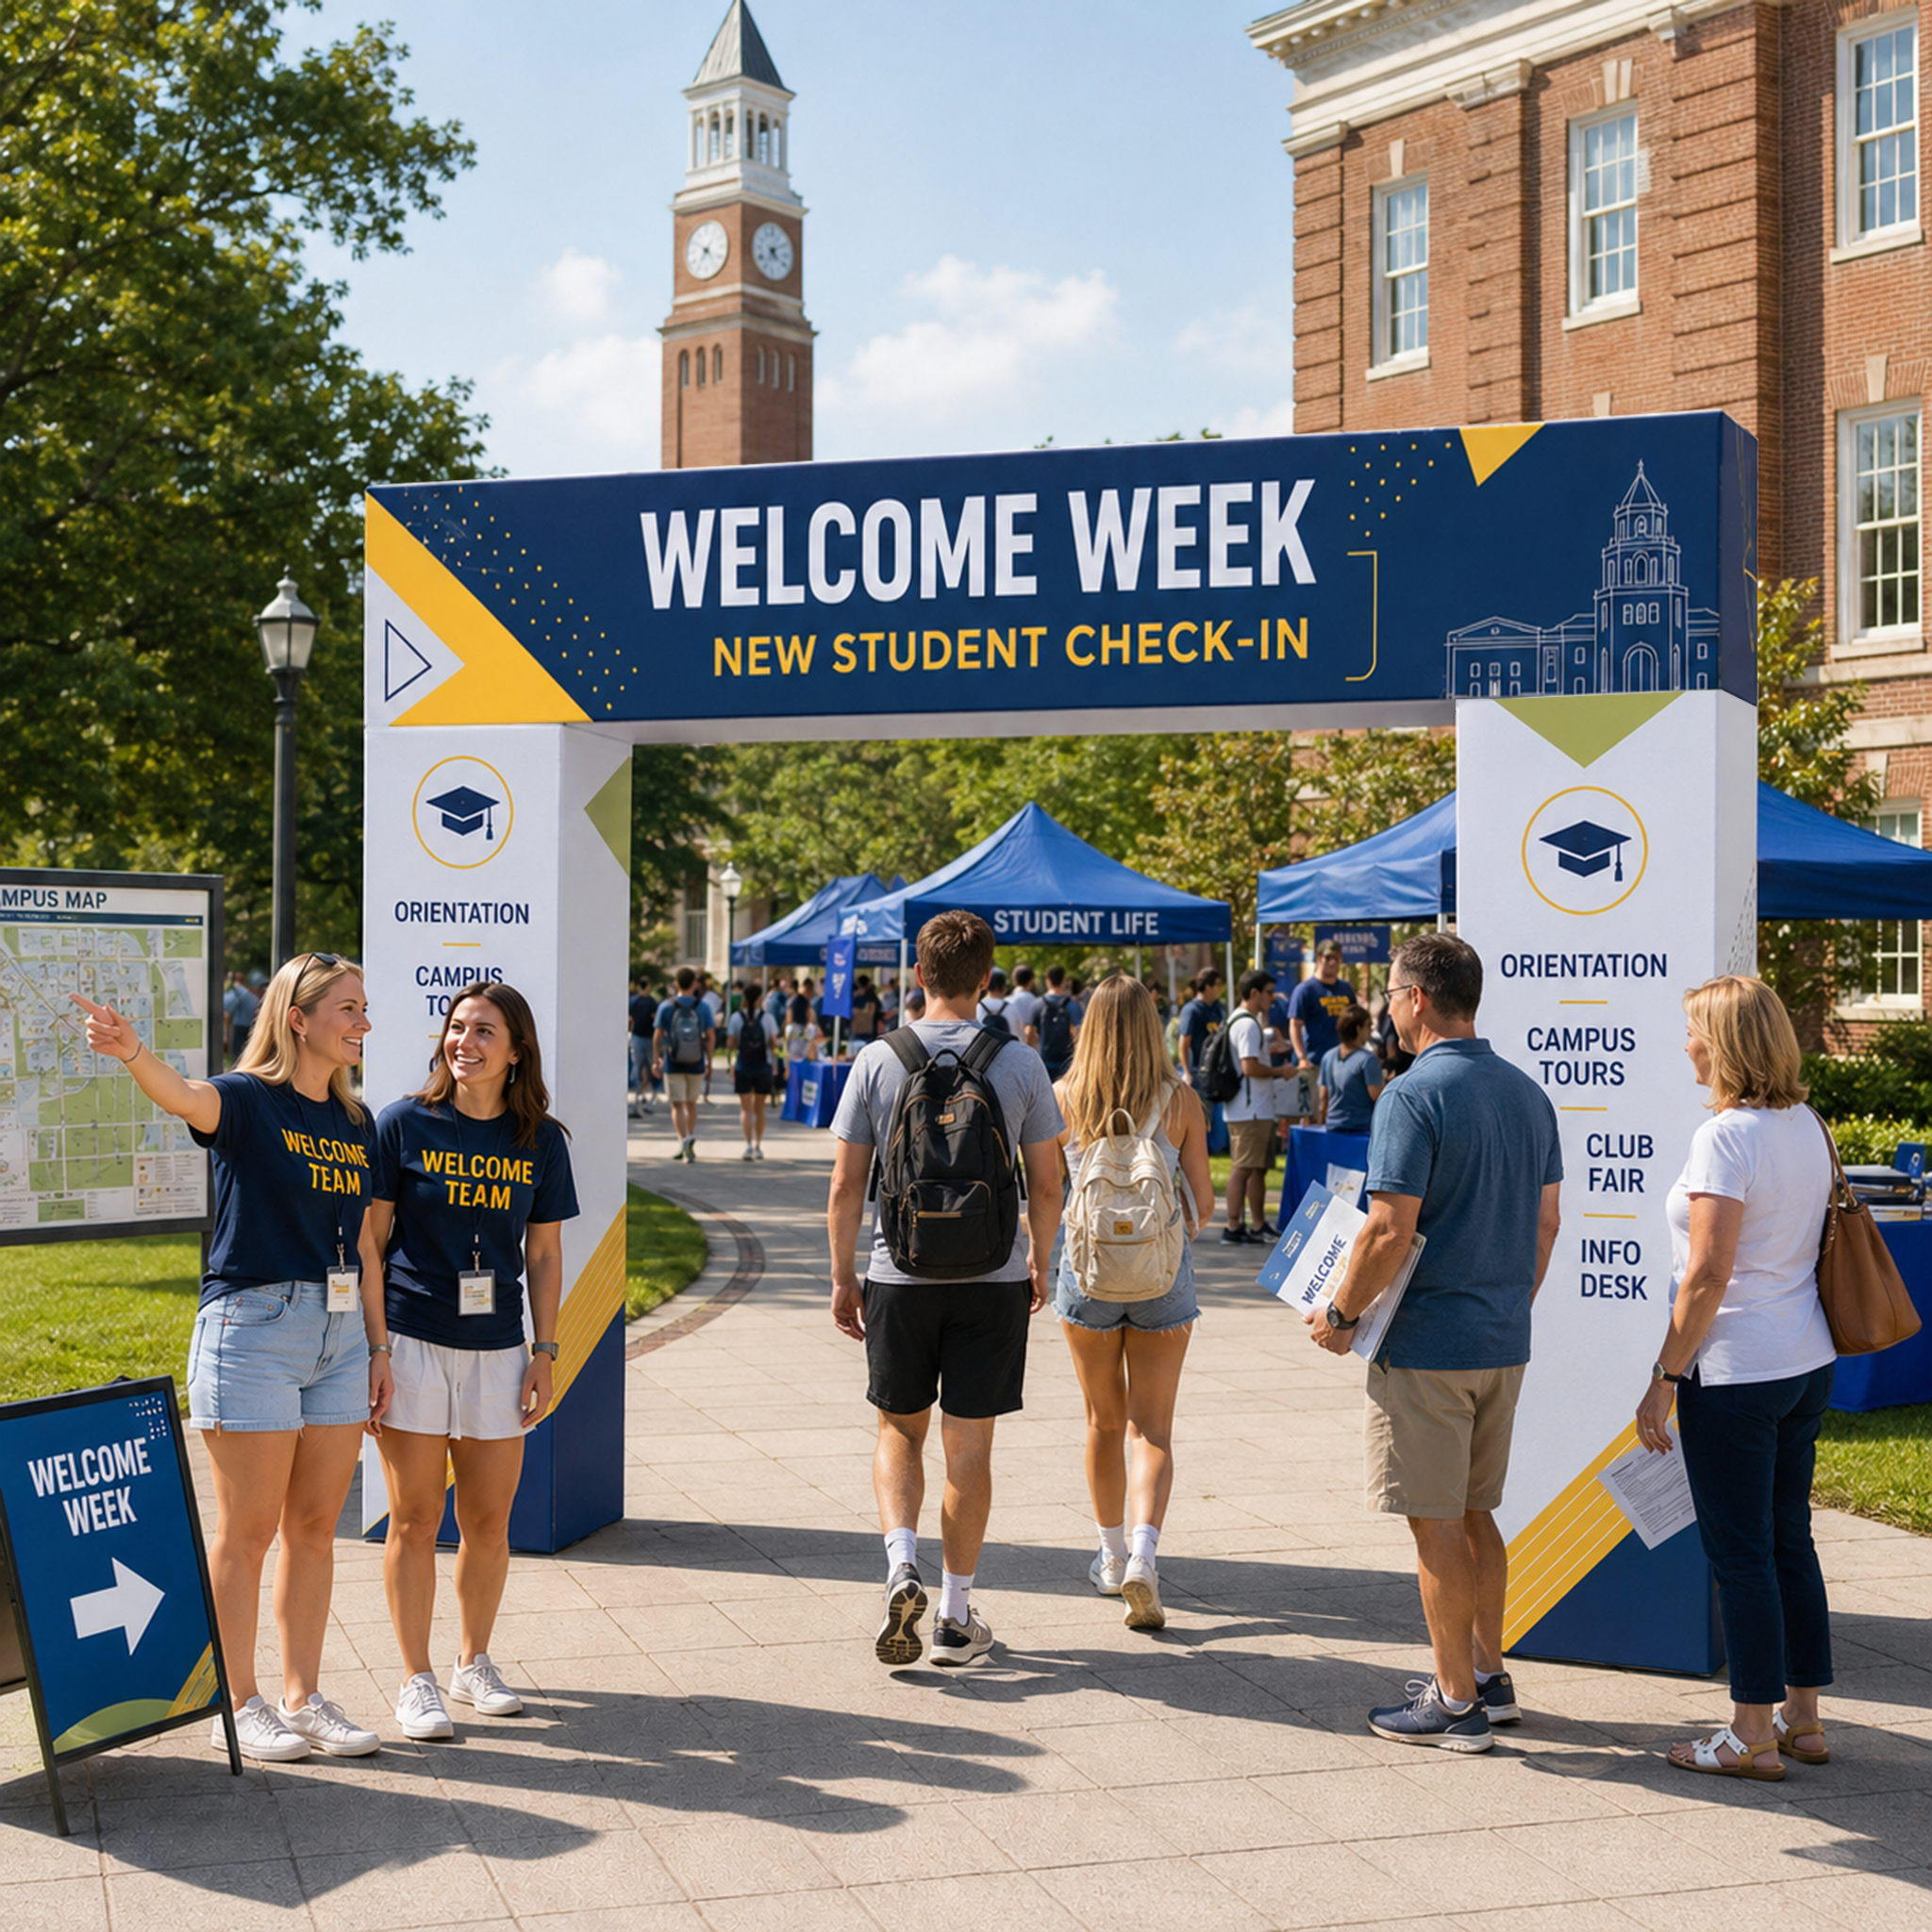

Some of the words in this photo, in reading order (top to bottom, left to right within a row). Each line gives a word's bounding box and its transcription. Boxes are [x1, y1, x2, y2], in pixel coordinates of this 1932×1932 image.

[640, 492, 1038, 609] WELCOME
[1068, 479, 1317, 592] WEEK
[714, 635, 817, 676] NEW
[832, 626, 1047, 674] STUDENT
[1065, 617, 1308, 667] CHECK-IN
[0, 889, 58, 908] MPUS
[65, 891, 108, 908] MAP
[394, 901, 529, 924] ORIENTATION
[993, 910, 1104, 933] STUDENT
[1111, 912, 1158, 935] LIFE
[415, 965, 503, 987] CAMPUS
[1501, 953, 1667, 978] ORIENTATION
[1527, 1026, 1636, 1053] CAMPUS
[1539, 1060, 1625, 1086] TOURS
[282, 1128, 370, 1169] WELCOME
[1587, 1133, 1654, 1159] CLUB
[308, 1162, 361, 1196] TEAM
[422, 1150, 534, 1185] WELCOME
[1589, 1167, 1644, 1193] FAIR
[444, 1180, 511, 1210] TEAM
[1581, 1239, 1641, 1266] INFO
[1301, 1234, 1347, 1305] WELCOME
[1580, 1273, 1648, 1301] DESK
[27, 1437, 153, 1498] WELCOME
[62, 1486, 138, 1537] WEEK
